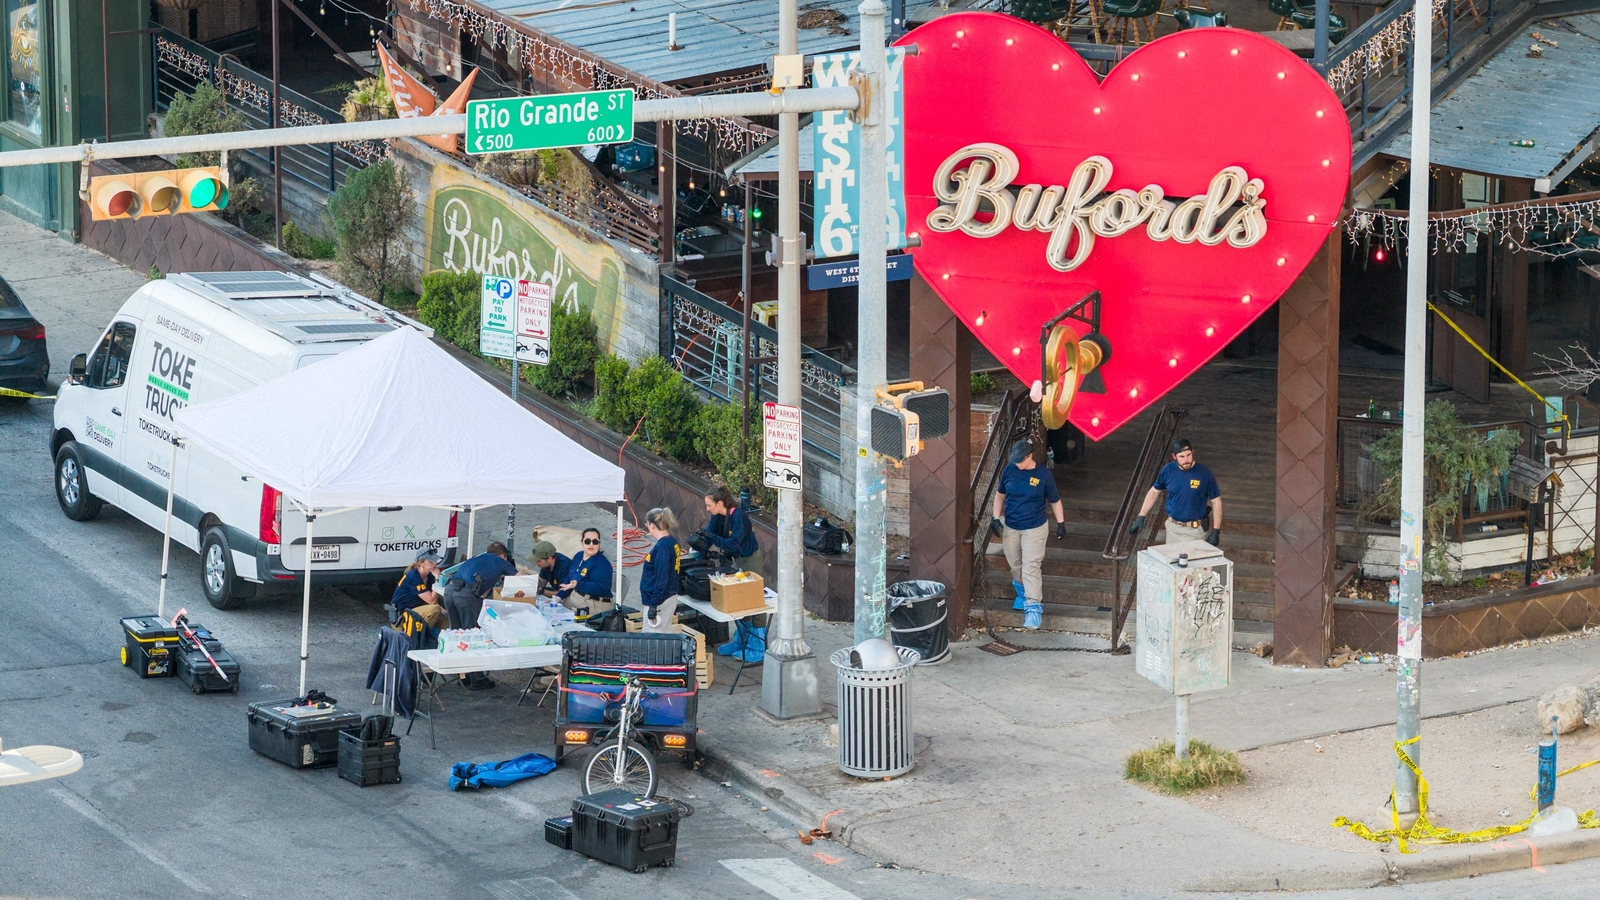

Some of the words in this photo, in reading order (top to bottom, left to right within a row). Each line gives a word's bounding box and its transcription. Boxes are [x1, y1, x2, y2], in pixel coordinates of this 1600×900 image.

[475, 103, 510, 130] Rio
[520, 96, 599, 126] Grande
[608, 93, 626, 110] ST
[587, 125, 614, 142] 600
[486, 133, 513, 150] 500
[926, 142, 1267, 272] Buford's
[819, 211, 858, 258] 6T
[825, 267, 848, 276] WEST
[849, 266, 859, 274] 6T
[518, 282, 528, 294] NO
[528, 286, 549, 296] PARKING
[492, 298, 505, 306] PAY
[520, 298, 549, 308] MOTORCYCLE
[489, 313, 507, 321] PARK
[520, 306, 547, 318] PARKING
[156, 314, 181, 334] SAME-DAY
[180, 326, 205, 345] DELIVERY
[525, 318, 541, 327] ONLY
[151, 340, 197, 391] TOKE
[145, 384, 188, 421] TRUC
[765, 405, 776, 418] NO
[776, 409, 798, 420] PARKING
[766, 420, 798, 432] MOTORCYCLE
[94, 431, 114, 449] DELIVERY
[768, 430, 797, 441] PARKING
[774, 442, 791, 452] ONLY
[374, 539, 442, 552] TOKETRUCKS
